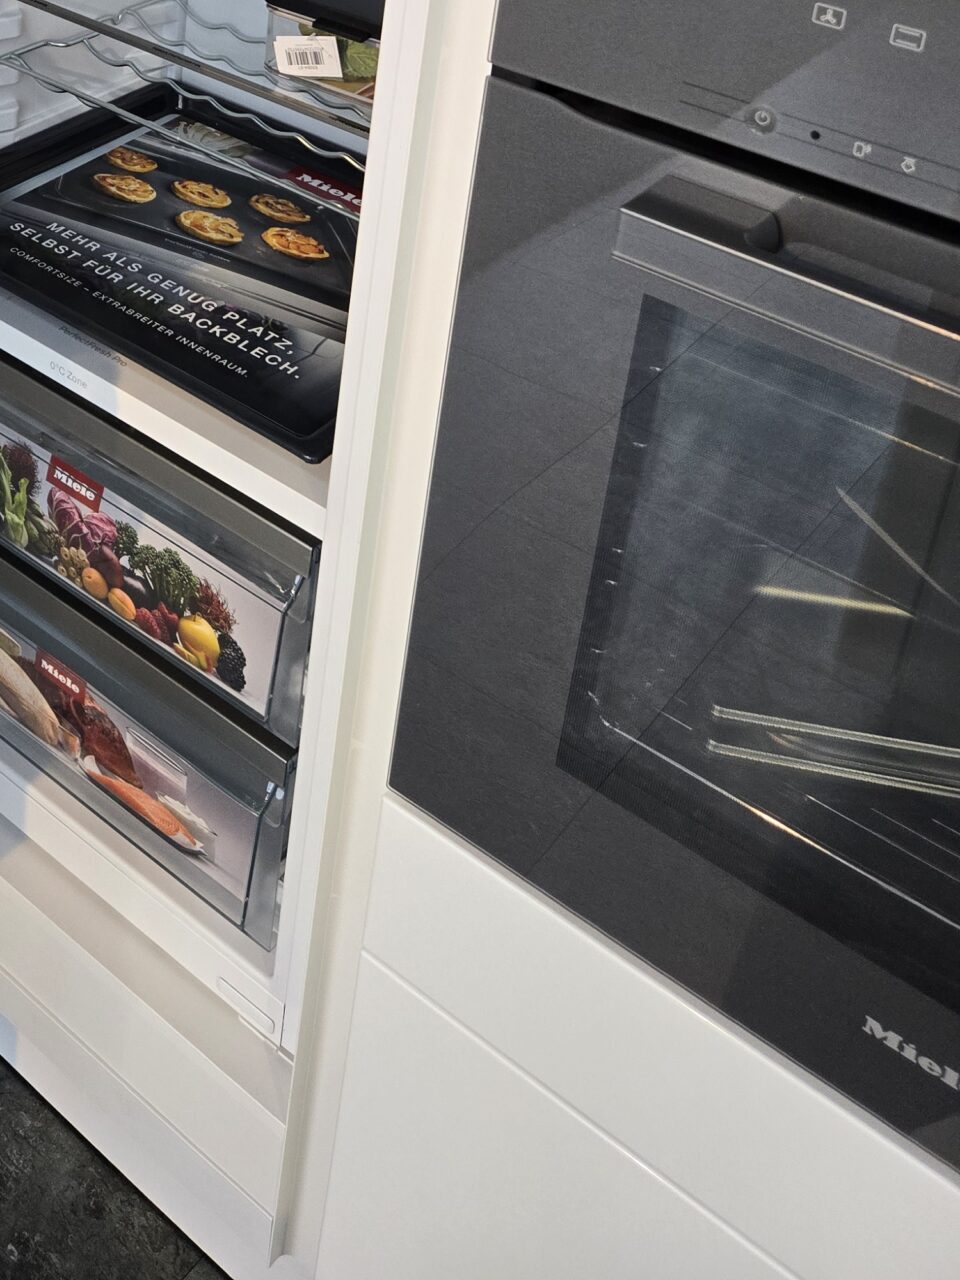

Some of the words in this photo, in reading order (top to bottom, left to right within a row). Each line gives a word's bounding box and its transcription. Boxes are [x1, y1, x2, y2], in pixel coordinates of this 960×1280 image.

[296, 173, 362, 206] Miele
[9, 222, 82, 259] SELBST
[82, 259, 124, 283] FÜR
[126, 282, 164, 305] IHR
[167, 303, 300, 379] BACKBLECH.
[46, 222, 100, 252] MEHR
[102, 252, 142, 273] ALS
[147, 273, 218, 312] GENUG
[222, 311, 293, 355] PLATZ,
[9, 247, 82, 288] COMFORTSIZE
[92, 291, 174, 336] EXTRABREITER
[175, 335, 248, 378] INNENRAUM.
[58, 325, 112, 358] PerfectFresh
[111, 355, 128, 368] Pro
[65, 371, 88, 389] Zone
[53, 465, 98, 502] Miele
[41, 658, 80, 694] Miele
[861, 1014, 960, 1091] Miel
